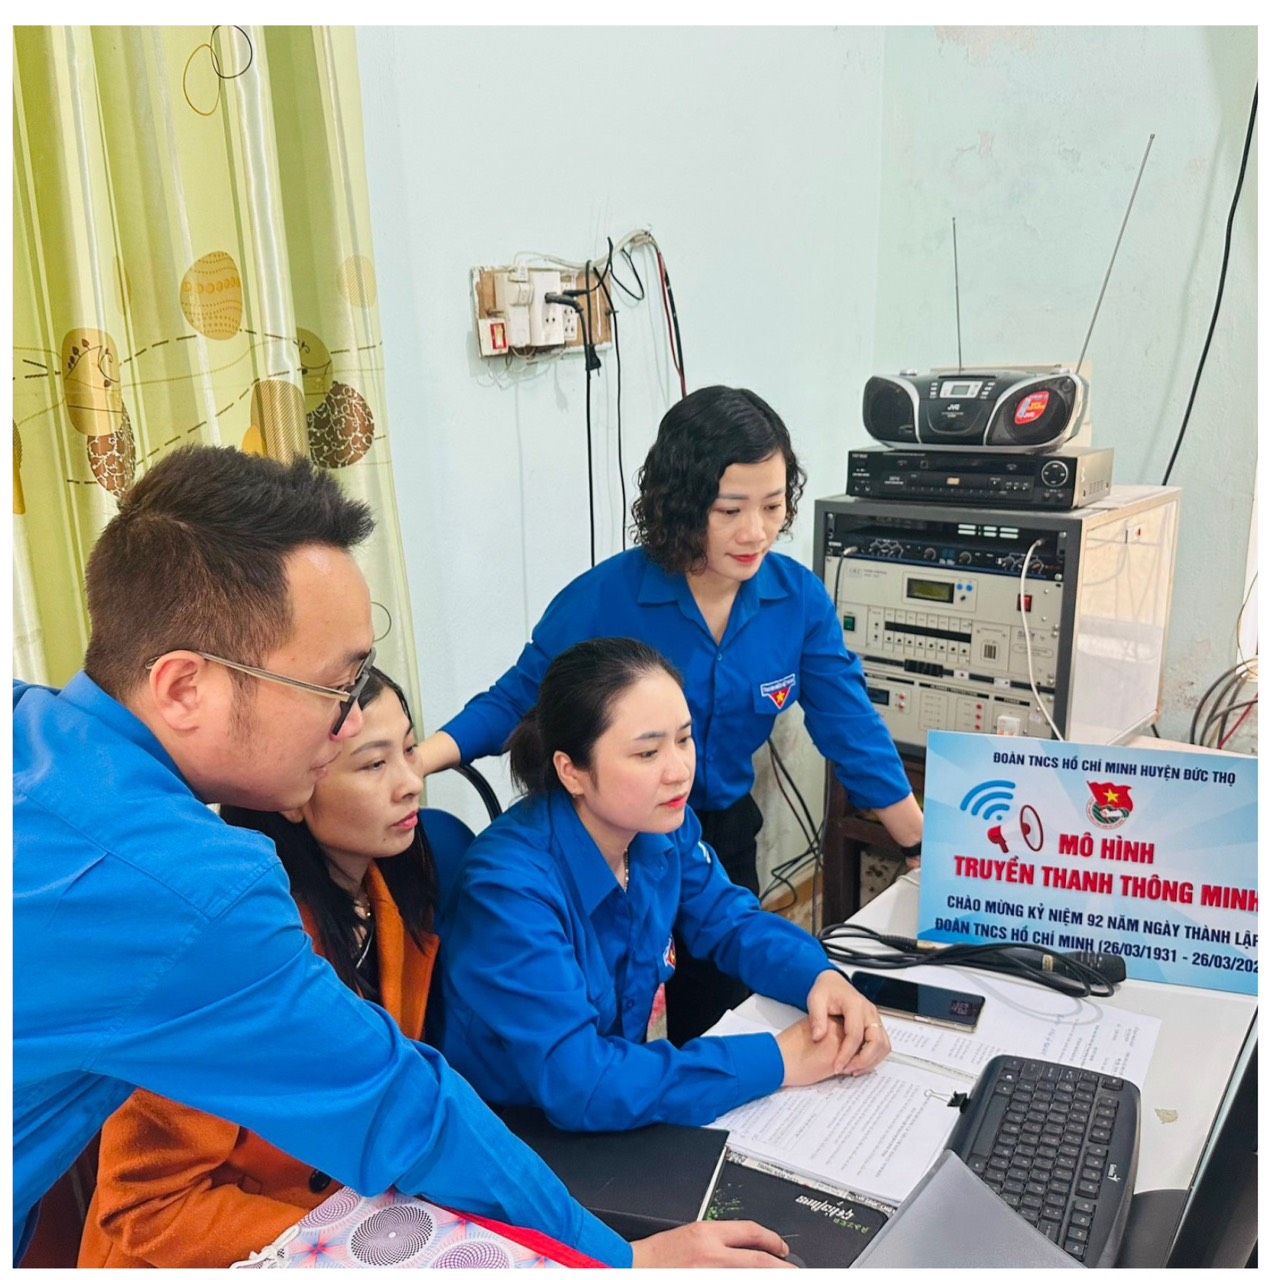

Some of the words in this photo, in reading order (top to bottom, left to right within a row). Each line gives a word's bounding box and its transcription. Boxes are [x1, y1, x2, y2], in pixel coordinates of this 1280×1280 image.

[993, 752, 1024, 766] ĐOÀN
[1028, 754, 1059, 769] TNCS
[1062, 753, 1079, 770] HỒ
[1081, 756, 1102, 772] CHÍ
[1105, 761, 1137, 776] MINH
[1140, 763, 1180, 782] HUYỆN
[1184, 765, 1209, 782] ĐỨC
[1212, 770, 1236, 786] THỌ
[1059, 832, 1094, 858] MÔ
[1101, 834, 1155, 864] HÌNH
[954, 855, 1035, 885] TRUYỀN
[1042, 866, 1114, 894] THANH
[1121, 872, 1193, 905] THÔNG
[935, 917, 970, 934] ĐOÀN
[973, 923, 1007, 940] TNCS
[1010, 925, 1029, 942] HỒ
[1032, 929, 1055, 946] CHÍ
[1058, 934, 1094, 951] MINH
[947, 895, 981, 912] CHÀO
[984, 898, 1024, 919] MỪNG
[1028, 901, 1045, 921] KỶ
[1048, 907, 1084, 927] NIỆM
[1087, 913, 1104, 928] 92
[1107, 915, 1139, 933] NĂM
[1143, 920, 1180, 938] NGÀY
[1184, 924, 1231, 944] THÀNH
